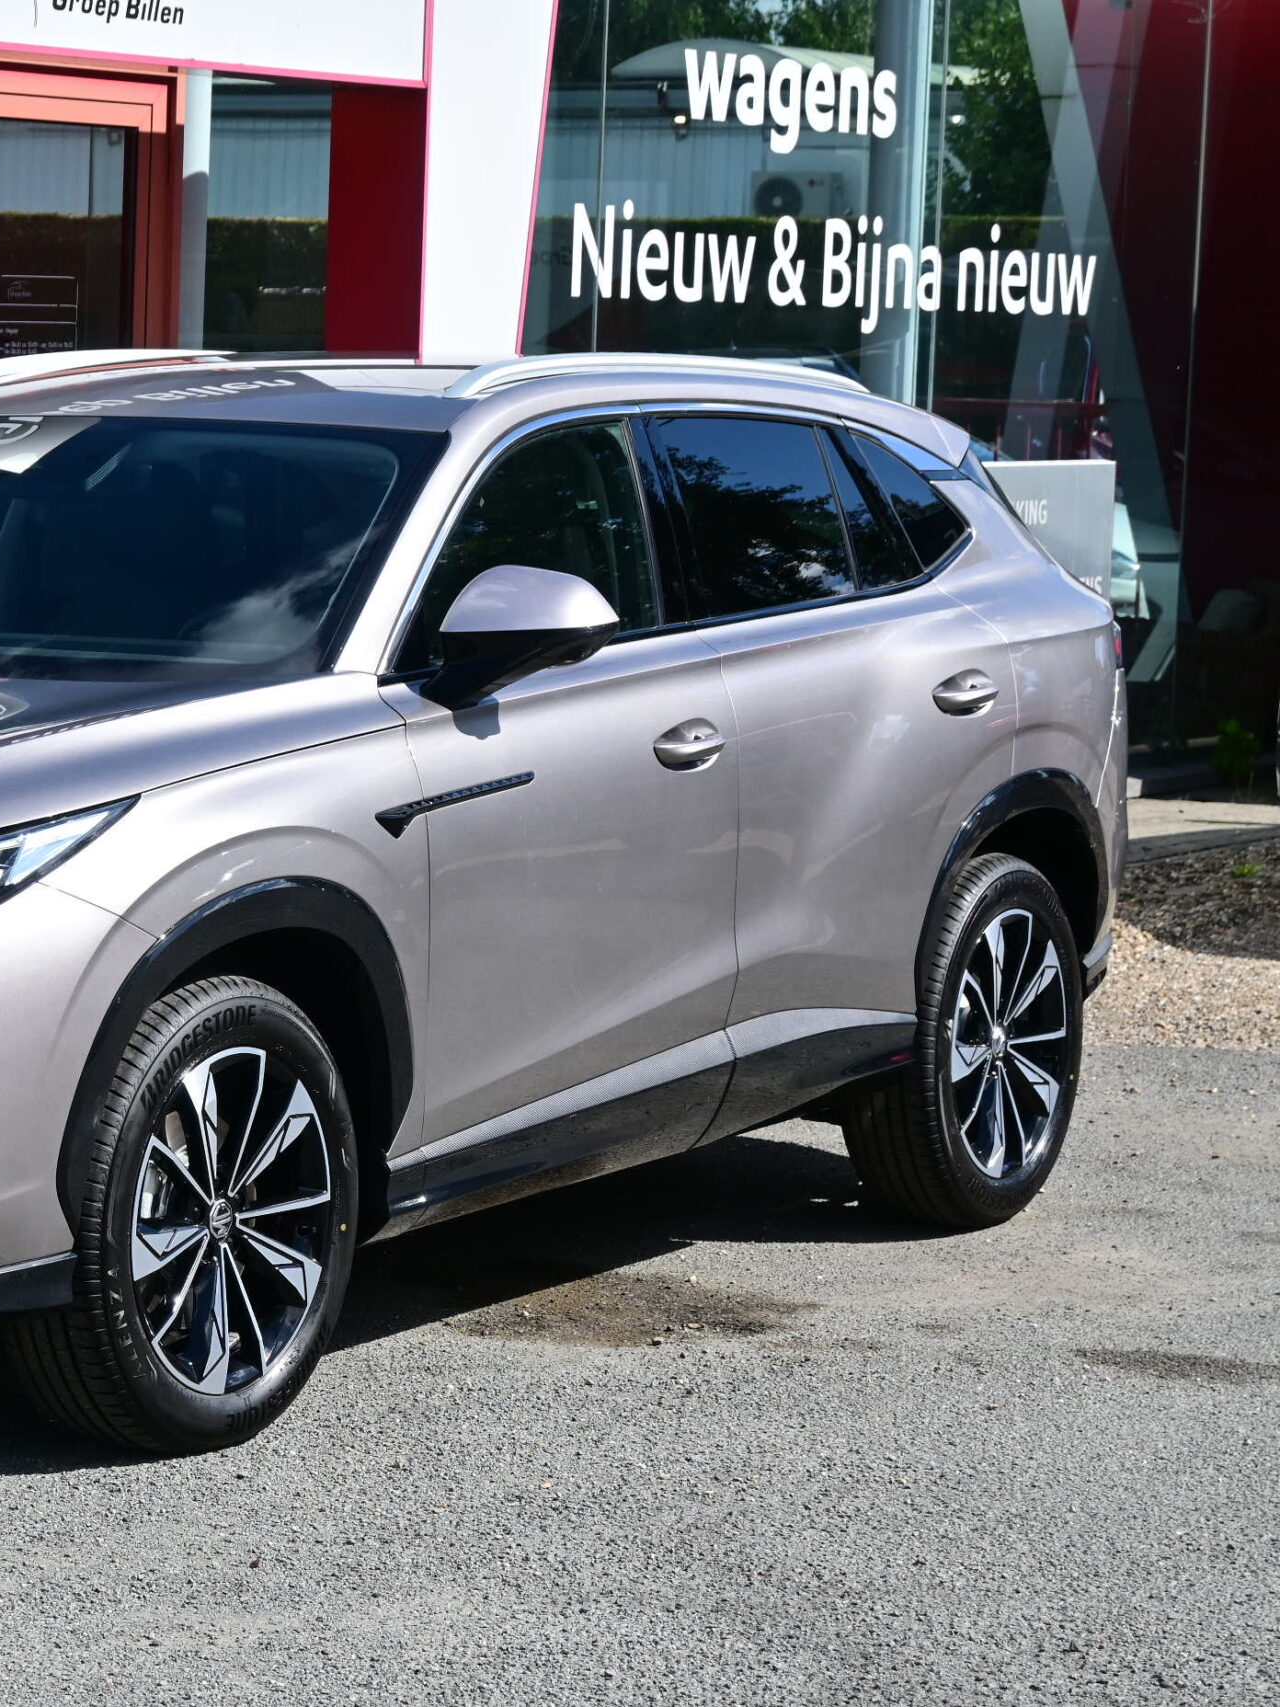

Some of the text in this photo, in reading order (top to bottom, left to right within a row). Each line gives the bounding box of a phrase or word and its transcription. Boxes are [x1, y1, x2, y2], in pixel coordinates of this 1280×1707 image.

[125, 0, 185, 25] Billen
[570, 199, 1097, 334] Nieuw & Bijna nieuw
[140, 1004, 258, 1112] BRIDGESTONE
